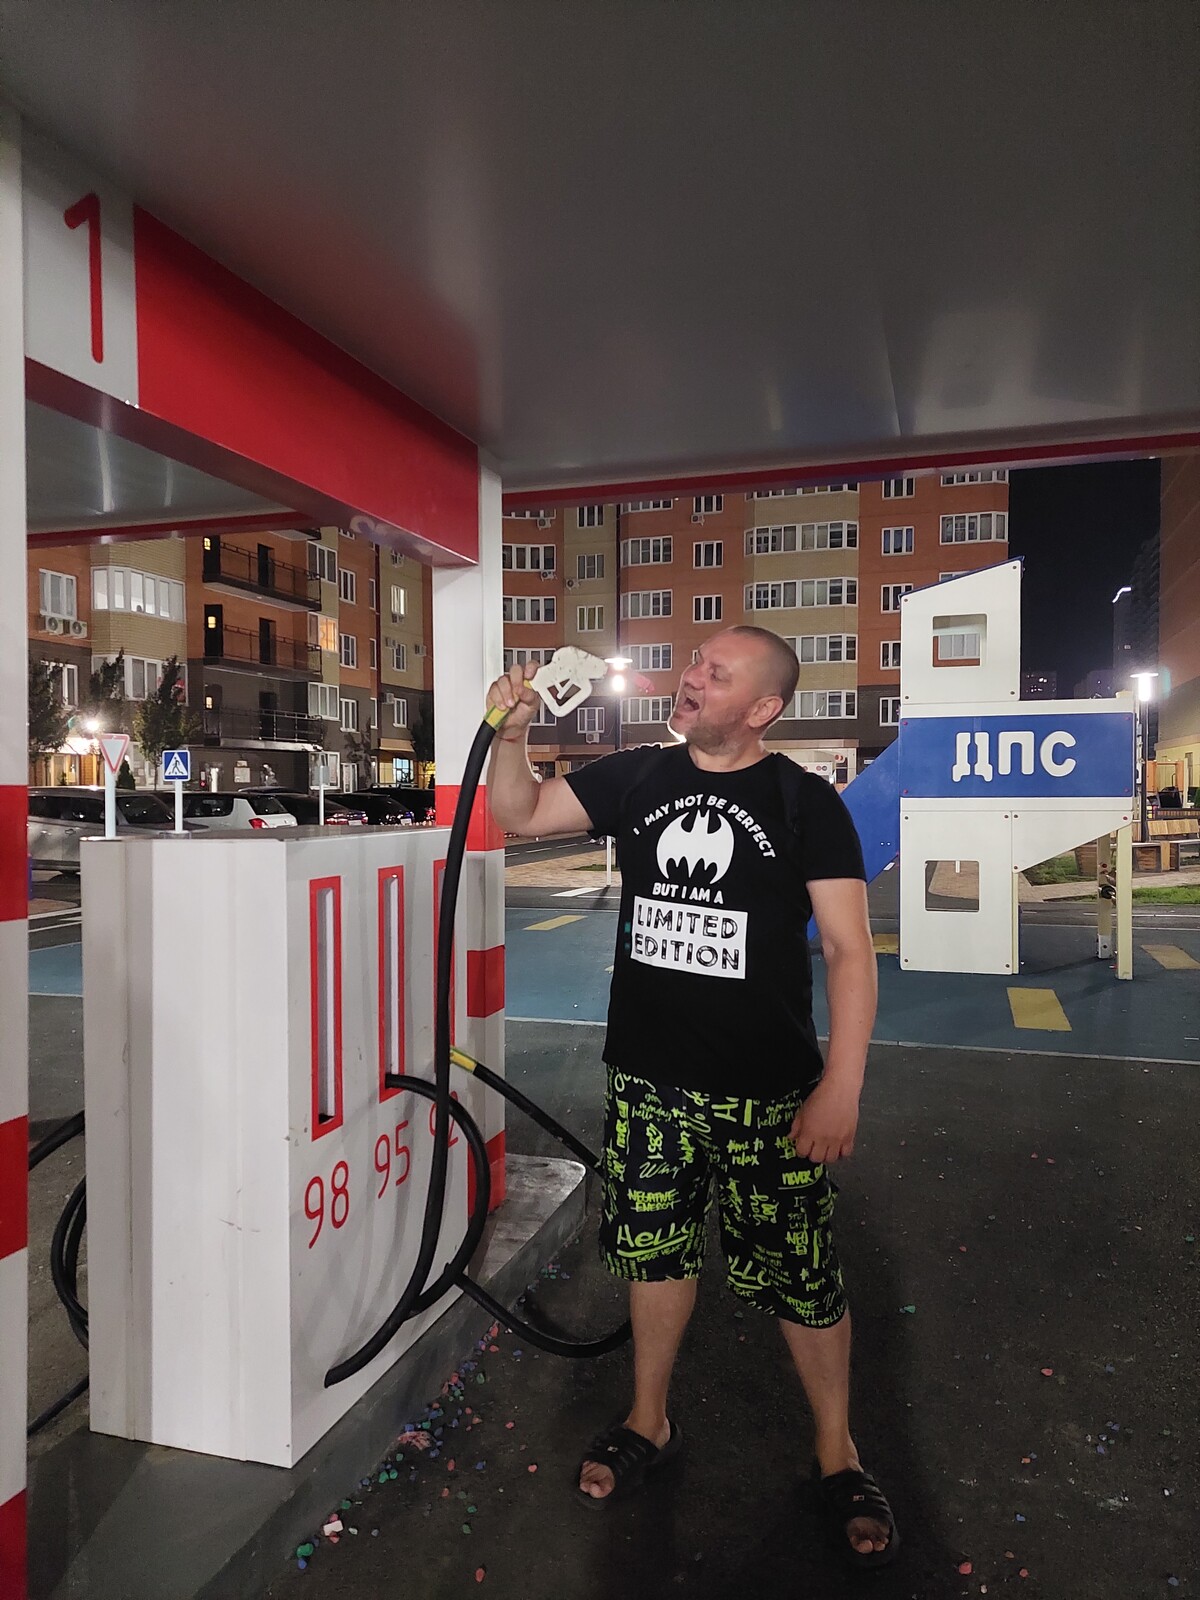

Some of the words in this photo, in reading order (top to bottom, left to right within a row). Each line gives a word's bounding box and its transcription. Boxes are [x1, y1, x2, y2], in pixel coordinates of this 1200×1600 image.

[64, 193, 104, 364] 1
[952, 731, 1077, 783] ДПС
[632, 826, 641, 836] I
[644, 803, 671, 827] MAY
[674, 793, 704, 811] NOT
[706, 794, 728, 811] BE
[727, 804, 777, 860] PERFECT
[652, 882, 679, 898] BUT
[681, 885, 687, 900] I
[689, 886, 711, 903] AM
[713, 889, 724, 905] A
[637, 904, 738, 940] LIMITED
[634, 932, 740, 970] EDITION
[374, 1119, 411, 1199] 95
[731, 1151, 760, 1167] relax
[304, 1160, 349, 1249] 98
